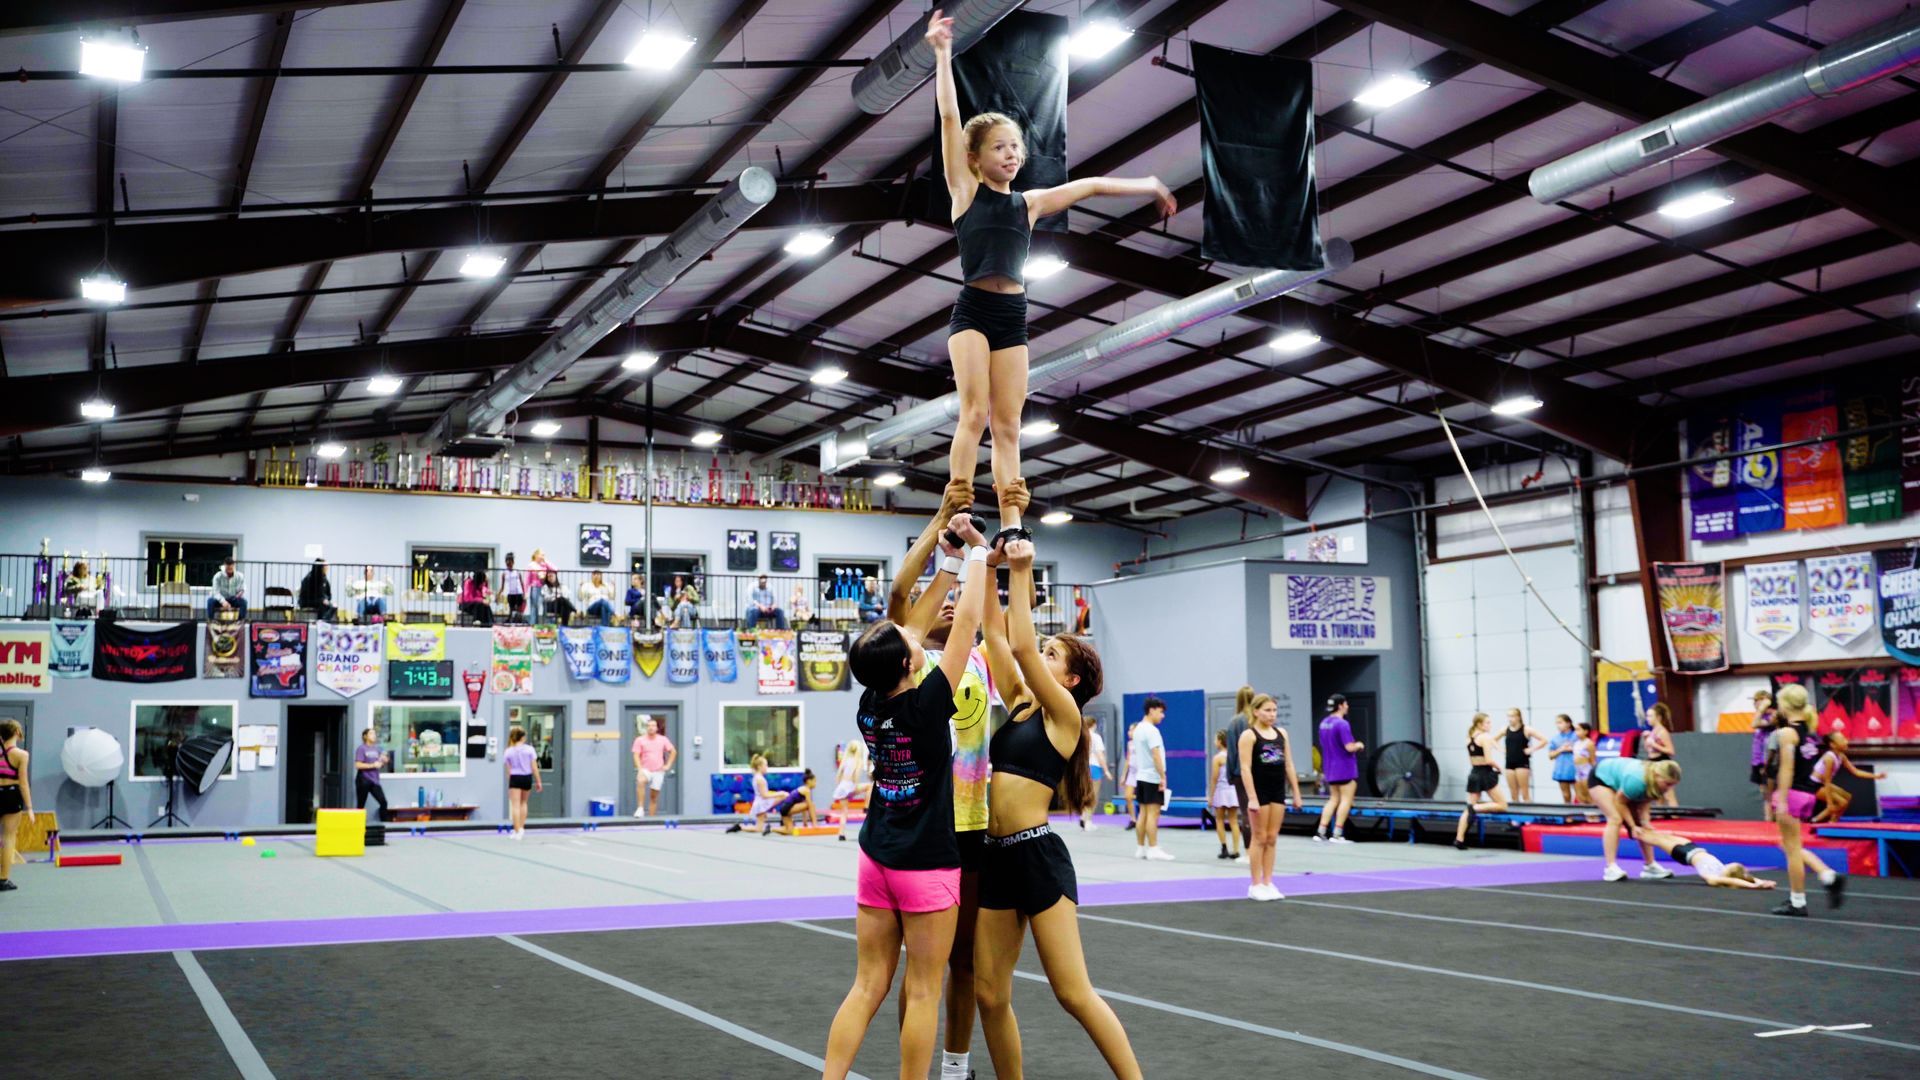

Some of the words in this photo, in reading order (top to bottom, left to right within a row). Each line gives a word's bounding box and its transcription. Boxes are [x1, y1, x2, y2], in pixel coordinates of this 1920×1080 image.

[1810, 564, 1870, 592] 2021
[1750, 575, 1797, 596] 2021
[1751, 597, 1799, 607] CHAMPION
[1811, 594, 1851, 607] GRAND
[1811, 604, 1873, 618] CHAMPION
[1290, 624, 1317, 638] CHEER
[1321, 624, 1328, 638] &
[1332, 624, 1375, 638] TUMBLING
[320, 632, 379, 653] 2021
[1895, 628, 1920, 649] 20
[319, 654, 360, 663] GRAND
[598, 649, 629, 661] ONE
[670, 649, 699, 661] ONE
[704, 649, 735, 662] ONE
[318, 664, 381, 673] CHAMPION
[404, 671, 437, 686] 7:43
